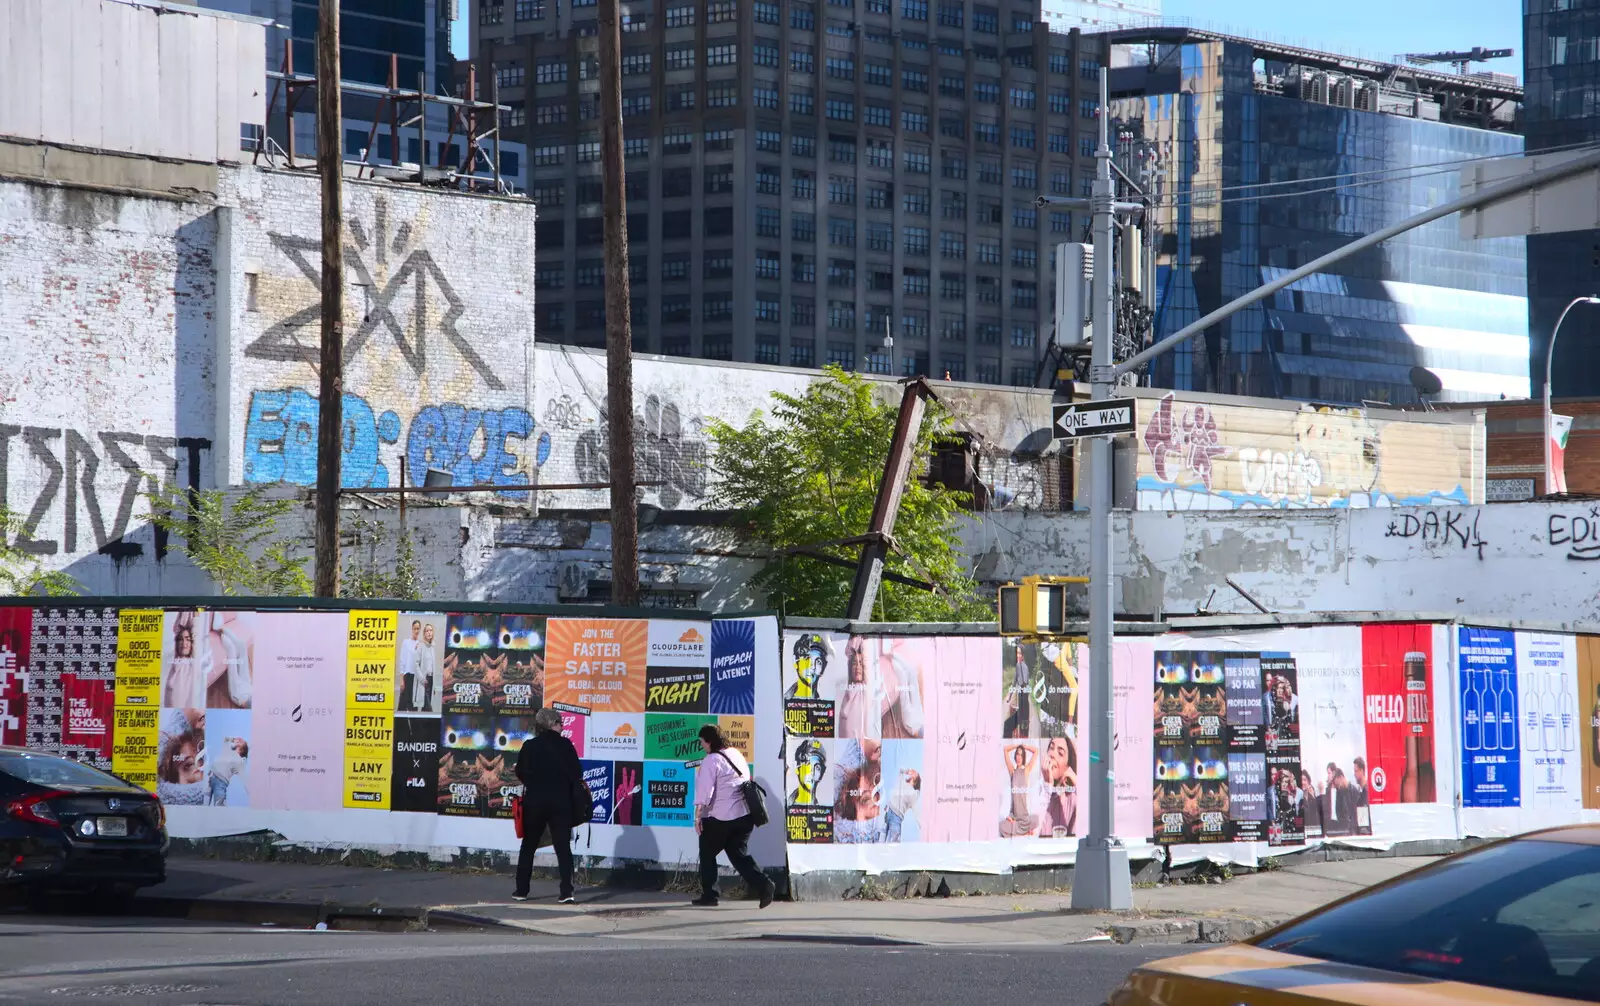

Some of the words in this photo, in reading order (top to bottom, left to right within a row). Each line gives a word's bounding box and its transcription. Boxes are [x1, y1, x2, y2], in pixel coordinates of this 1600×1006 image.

[1065, 413, 1088, 427] ONE
[1100, 410, 1125, 424] WAY
[120, 615, 138, 623] THEY
[139, 615, 163, 623] MIGHT
[356, 618, 389, 628] PETIT
[122, 624, 131, 632] BE
[133, 624, 159, 632] GIANTS
[349, 630, 396, 641] BISCUIT
[582, 629, 597, 638] JOIN
[600, 629, 615, 638] THE
[129, 641, 150, 649] GOOD
[573, 642, 622, 657] FASTER
[652, 643, 704, 651] CLOUDFLARE
[117, 650, 161, 659] CHARLOTTE
[713, 651, 753, 669] IMPEACH
[356, 664, 386, 674] LANY
[565, 660, 628, 676] SAFER
[717, 665, 751, 681] LATENCY
[1225, 667, 1237, 676] THE
[1238, 667, 1260, 676] STORY
[1341, 667, 1360, 678] SONS
[116, 677, 127, 685] THE
[128, 677, 160, 685] WOMBATS
[568, 680, 596, 689] GLOBAL
[598, 681, 623, 690] CLOUD
[1232, 680, 1241, 689] SO
[1243, 680, 1256, 689] FAR
[453, 683, 481, 692] GRETA
[503, 684, 532, 694] GRETA
[1049, 685, 1056, 693] do
[379, 693, 384, 701] 5
[647, 680, 706, 707] RIGHT
[69, 698, 86, 707] THE
[456, 694, 481, 704] FLEET
[506, 695, 530, 705] FLEET
[578, 694, 612, 704] NETWORK
[1227, 699, 1247, 708] PROPER
[1248, 699, 1262, 707] DOSE
[70, 708, 92, 717] NEW
[1366, 695, 1404, 723] HELLO
[1407, 694, 1429, 723] HELLS
[116, 710, 134, 718] THEY
[135, 710, 159, 718] MIGHT
[785, 710, 807, 722] LOUIS
[69, 718, 105, 727] SCHOOL
[118, 719, 127, 728] BE
[129, 719, 155, 728] GIANTS
[353, 716, 386, 727] PETIT
[1161, 716, 1183, 726] GRETA
[1198, 716, 1220, 726] GRETA
[647, 719, 686, 735] PERFORMANCE
[790, 722, 811, 734] CHILD
[1164, 726, 1182, 735] FLEET
[1201, 726, 1219, 735] FLEET
[346, 729, 392, 740] BISCUIT
[658, 733, 669, 743] AND
[670, 728, 698, 741] SECURITY
[730, 731, 750, 739] MILLION
[126, 736, 146, 745] GOOD
[591, 737, 637, 745] CLOUDFLARE
[113, 746, 157, 754] CHARLOTTE
[397, 742, 437, 752] BANDIER
[353, 762, 383, 773] LANY
[1229, 762, 1241, 771] THE
[1242, 761, 1263, 772] STORY
[126, 773, 157, 781] WOMBATS
[582, 766, 606, 780] BETTER
[663, 768, 678, 778] KEEP
[406, 777, 425, 787] FILA
[1235, 774, 1245, 784] SO
[1247, 774, 1260, 784] FAR
[449, 783, 478, 794] GRETA
[651, 784, 685, 793] HACKER
[452, 794, 477, 805] FLEET
[654, 798, 684, 806] HANDS
[1230, 793, 1251, 802] PROPER
[1252, 793, 1265, 802] DOSE
[655, 812, 667, 820] YOUR
[1161, 813, 1184, 823] GRETA
[1201, 812, 1224, 822] GRETA
[787, 816, 807, 828] LOUIS
[1203, 822, 1222, 831] FLEET
[1164, 823, 1183, 832] FLEET
[791, 827, 811, 840] CHILD
